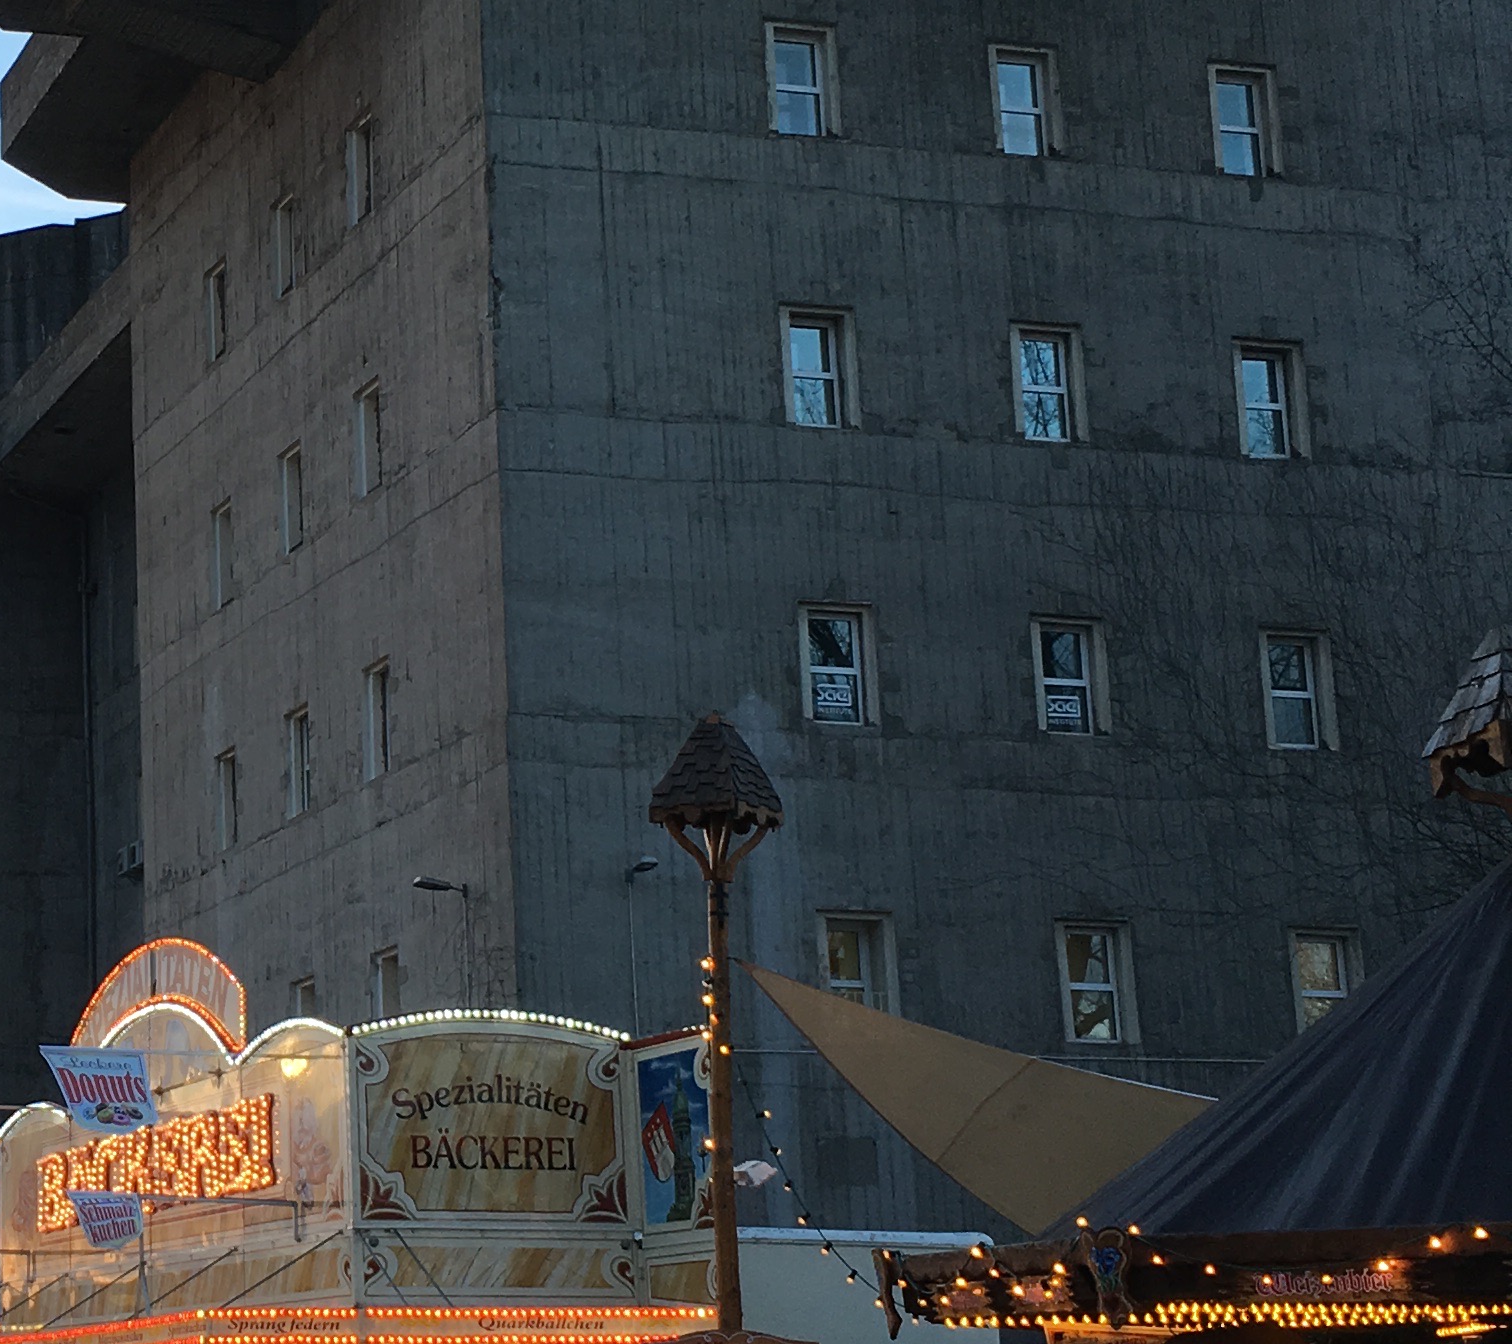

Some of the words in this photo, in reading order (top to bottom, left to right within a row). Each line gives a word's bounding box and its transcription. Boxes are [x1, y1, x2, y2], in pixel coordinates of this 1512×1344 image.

[57, 1067, 148, 1105] Donuts
[391, 1073, 589, 1126] Spezialitäten
[409, 1127, 577, 1171] BÄCKEREI
[88, 1217, 136, 1244] kuchen
